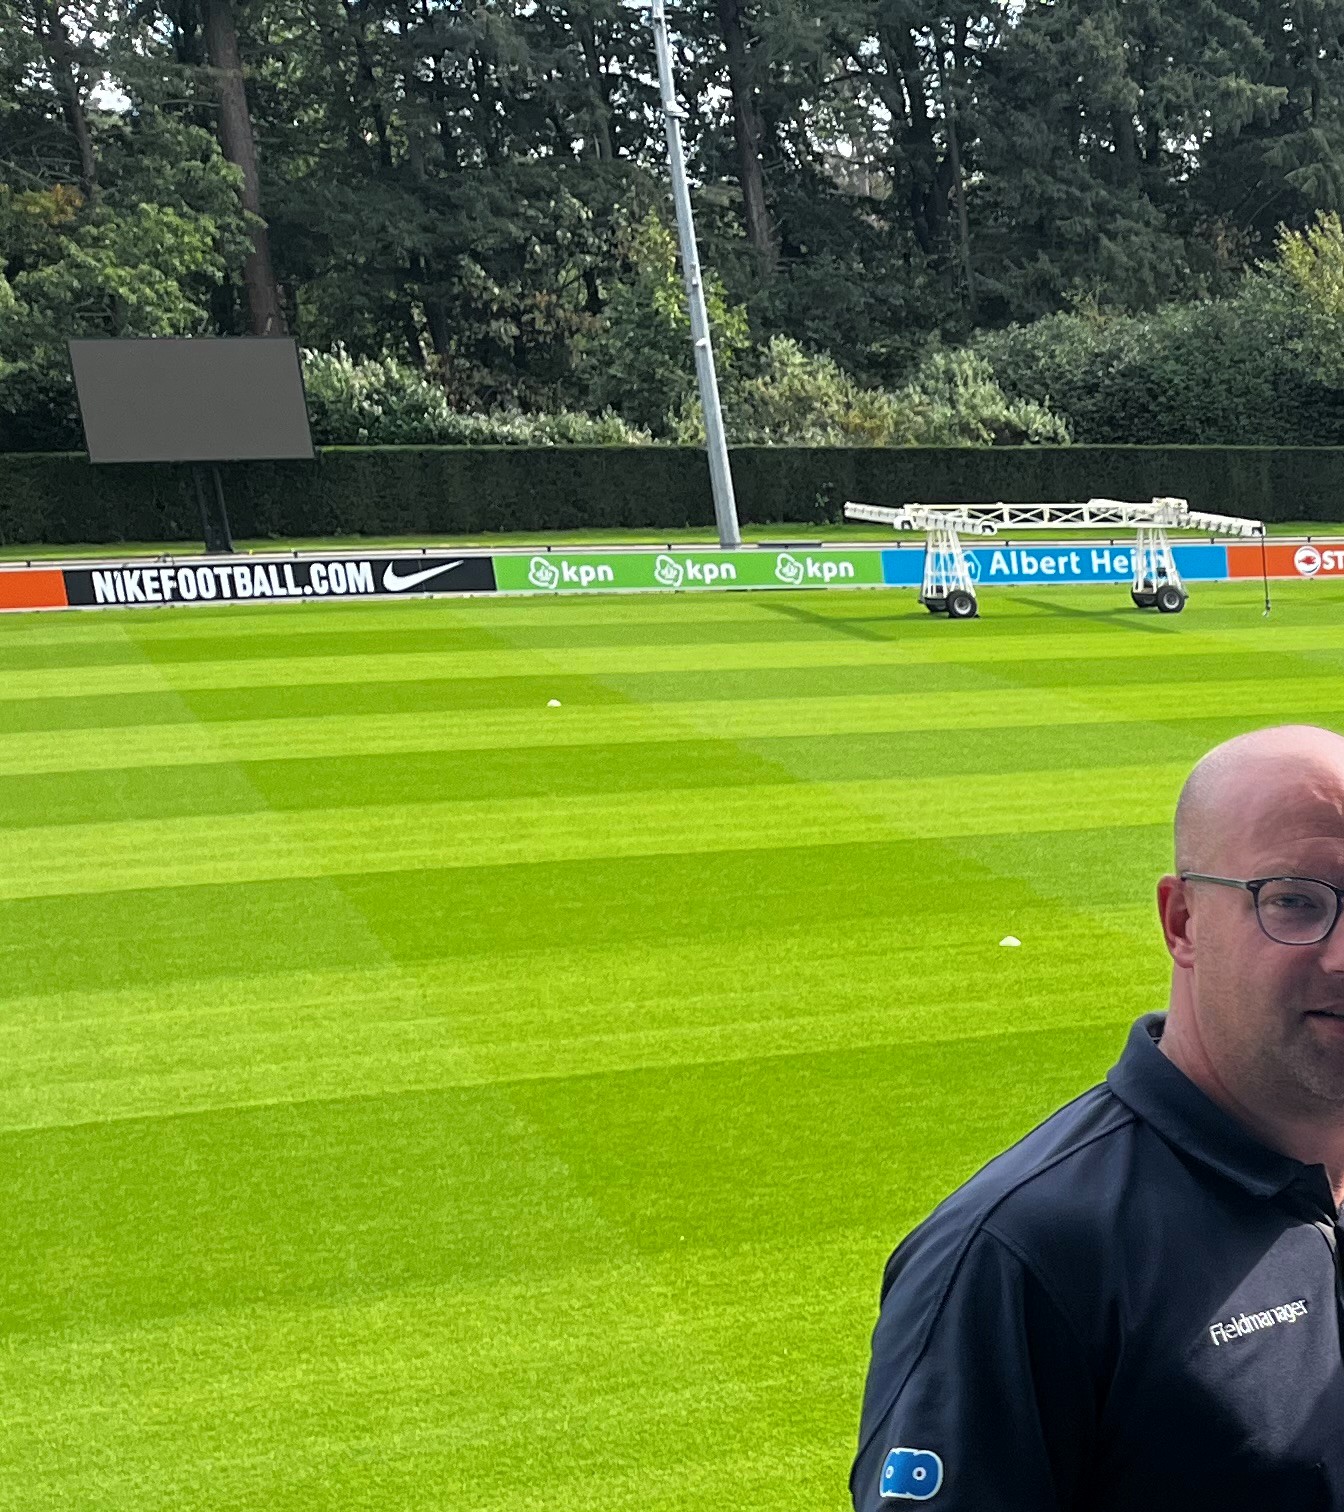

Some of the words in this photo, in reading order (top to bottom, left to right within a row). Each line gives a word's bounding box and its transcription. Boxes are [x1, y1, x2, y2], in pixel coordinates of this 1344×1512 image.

[562, 560, 614, 588] kpn
[686, 557, 737, 583] kpn
[806, 557, 855, 581] kpn
[989, 549, 1081, 576] Albert
[92, 561, 374, 604] NIKEFOOTBALL.COM
[1209, 1299, 1308, 1346] Fieldmanager
